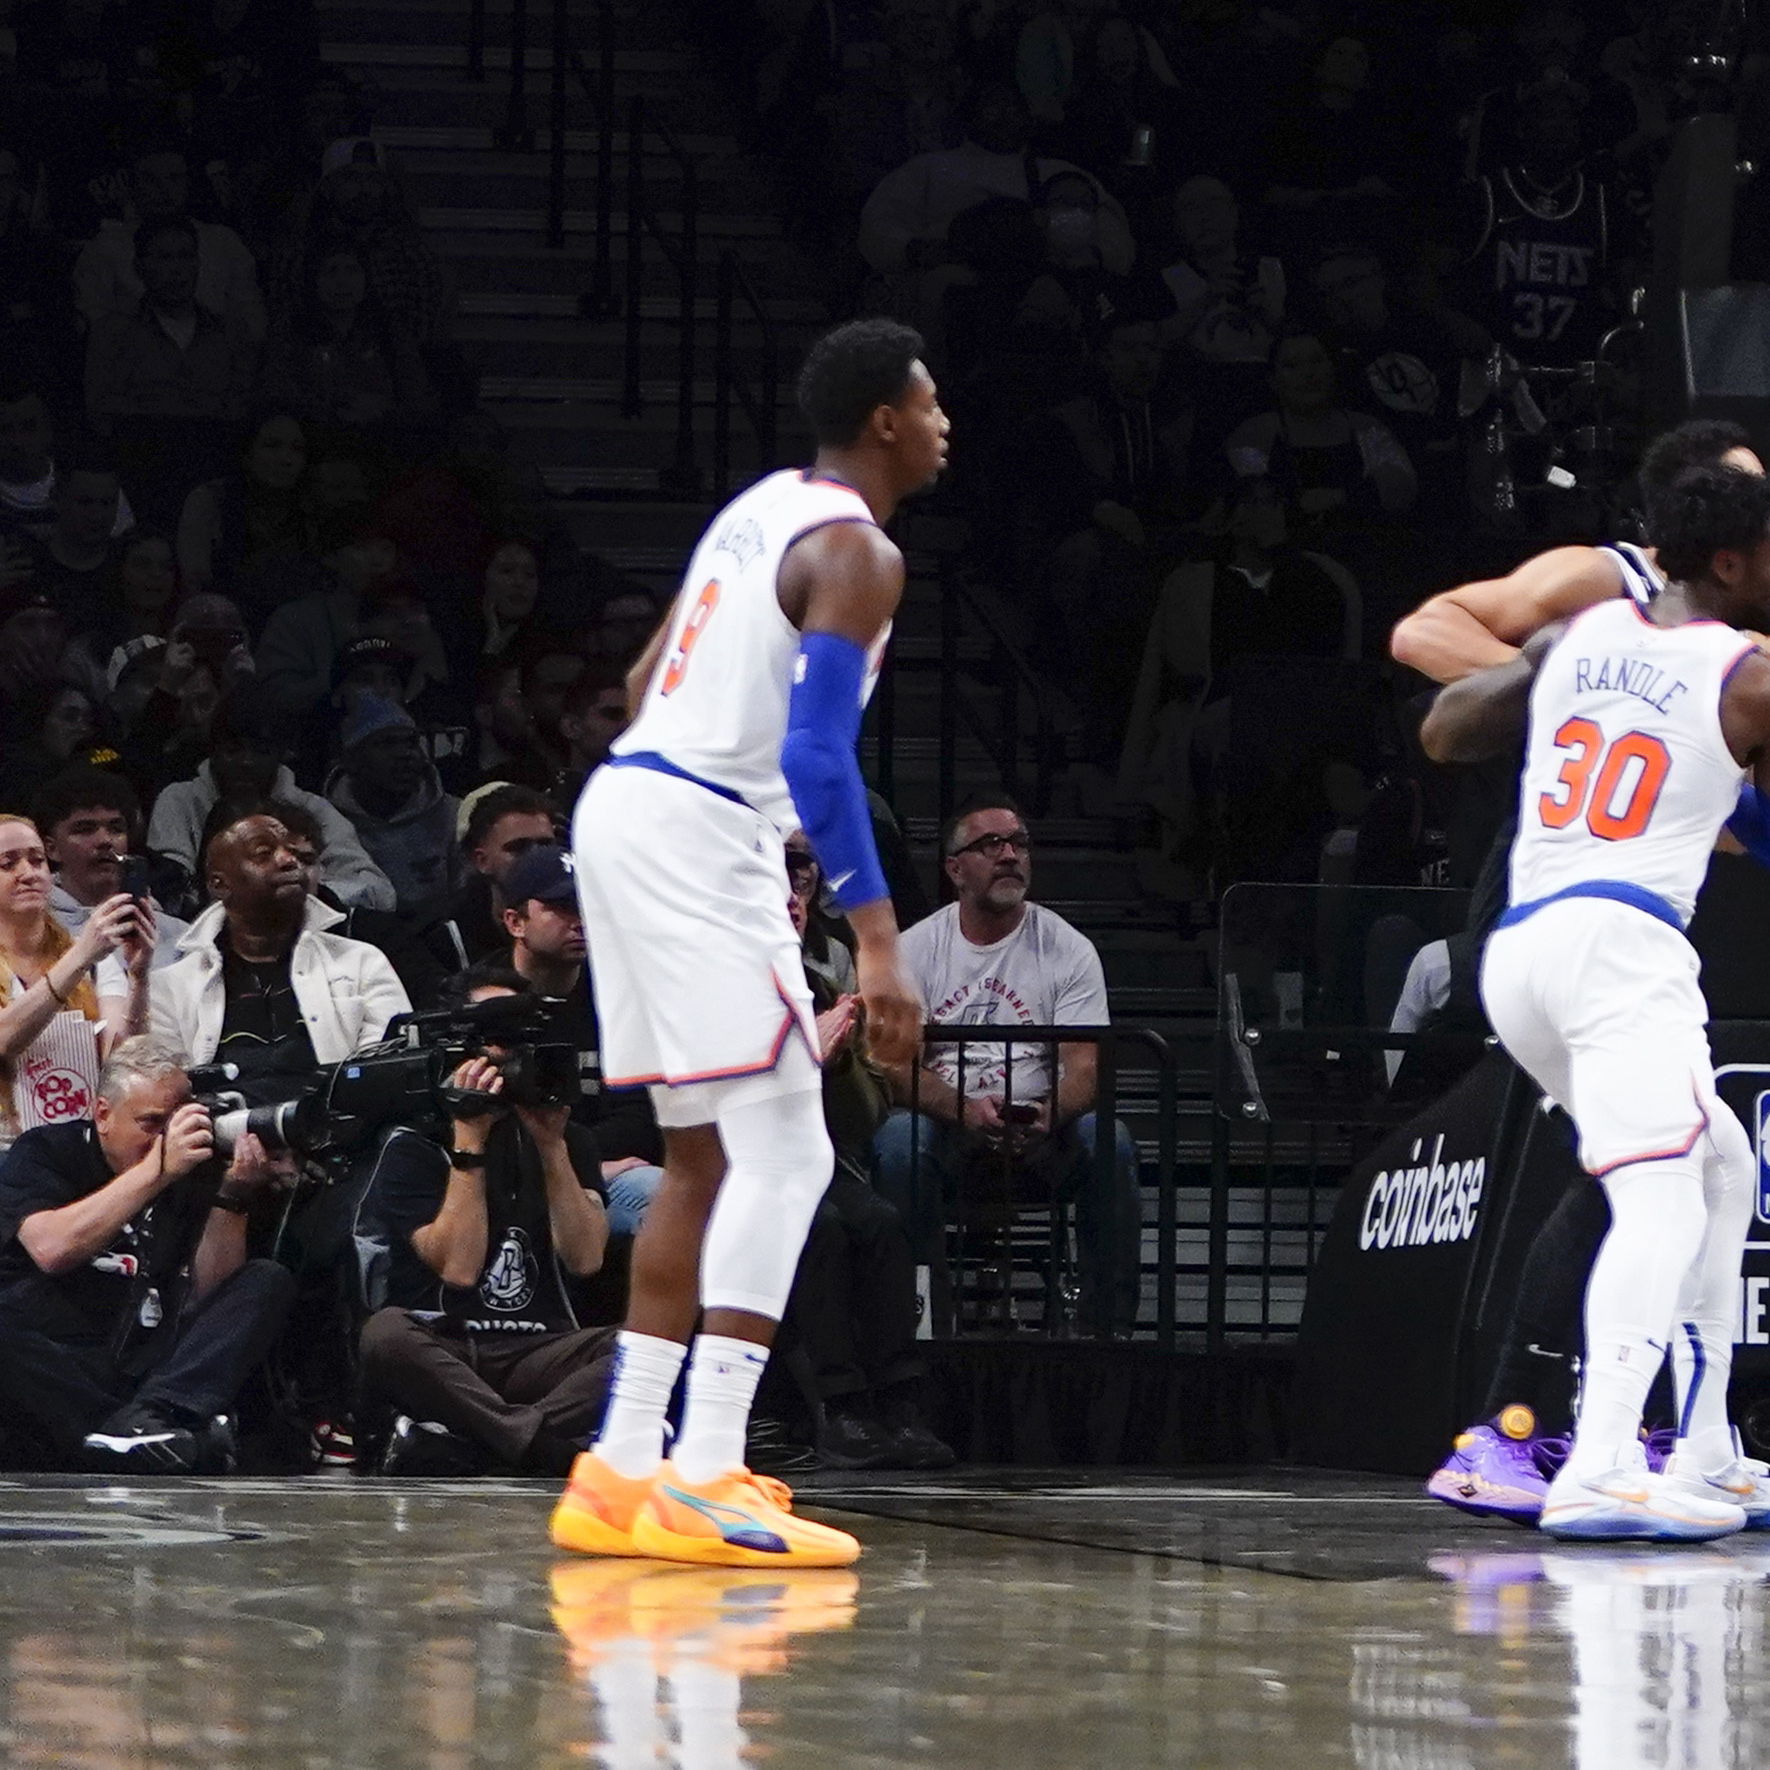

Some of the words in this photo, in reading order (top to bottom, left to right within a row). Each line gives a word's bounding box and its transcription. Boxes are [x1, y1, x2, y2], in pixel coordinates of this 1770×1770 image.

[1497, 240, 1595, 290] NETS
[1512, 292, 1577, 342] 37
[1576, 657, 1688, 716] RANDLE
[1538, 715, 1673, 842] 30
[1361, 1133, 1485, 1251] coinbase
